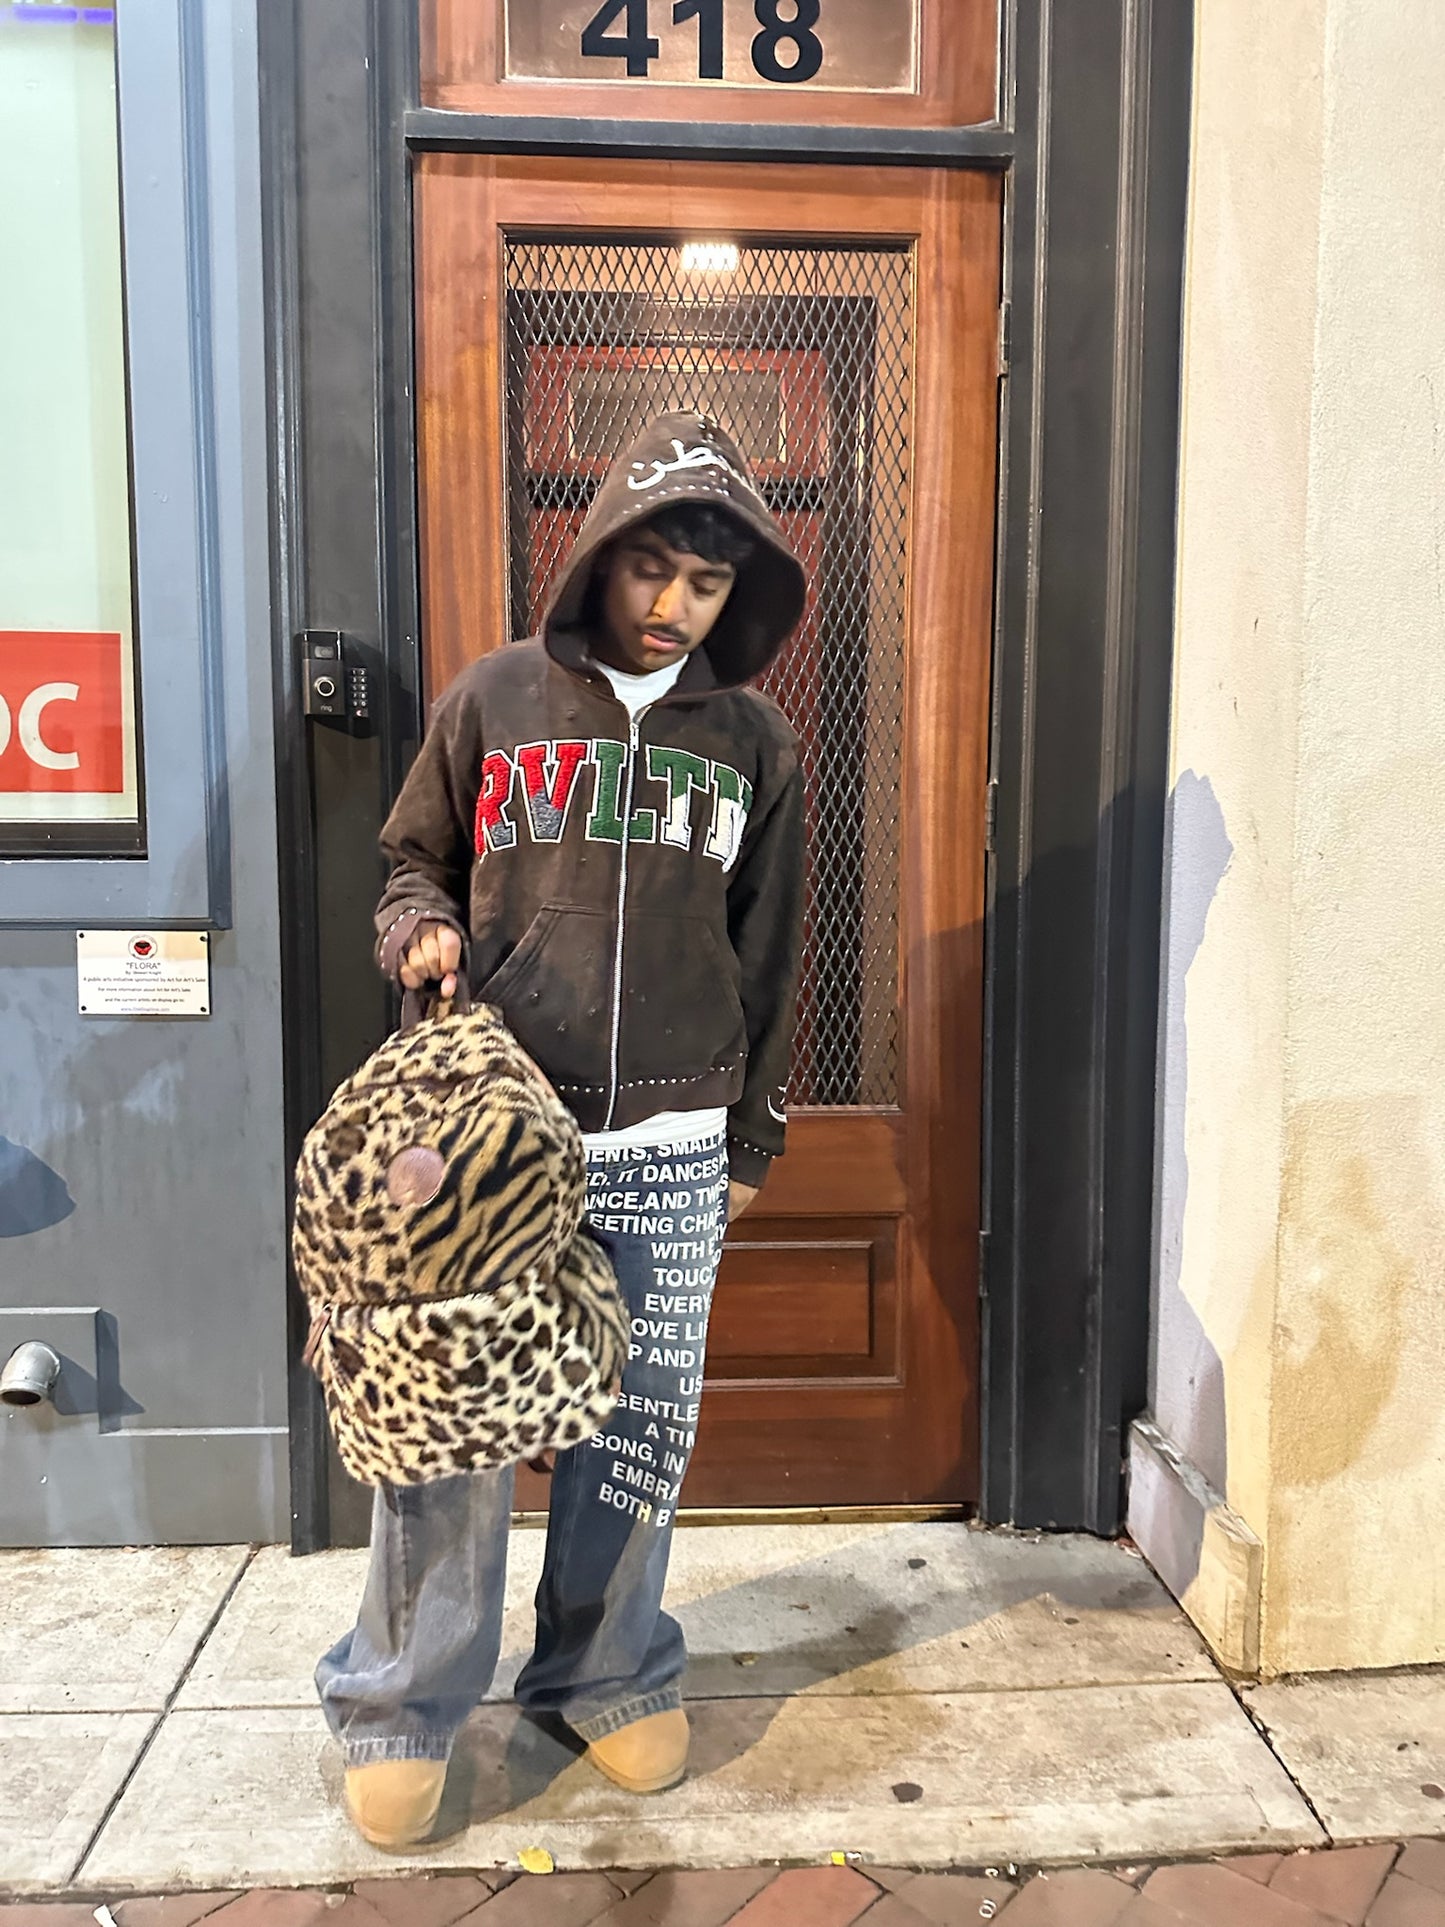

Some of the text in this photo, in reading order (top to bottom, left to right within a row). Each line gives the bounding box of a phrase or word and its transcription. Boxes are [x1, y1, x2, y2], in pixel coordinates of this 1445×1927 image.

[581, 0, 823, 83] 418
[320, 703, 333, 712] ring
[0, 681, 80, 770] C
[126, 962, 161, 970] "FLORA"
[650, 1240, 705, 1260] WITH
[646, 1346, 696, 1368] AND
[644, 1421, 660, 1440] A
[590, 1432, 685, 1475] SONG, IN
[598, 1482, 653, 1524] BOTH
